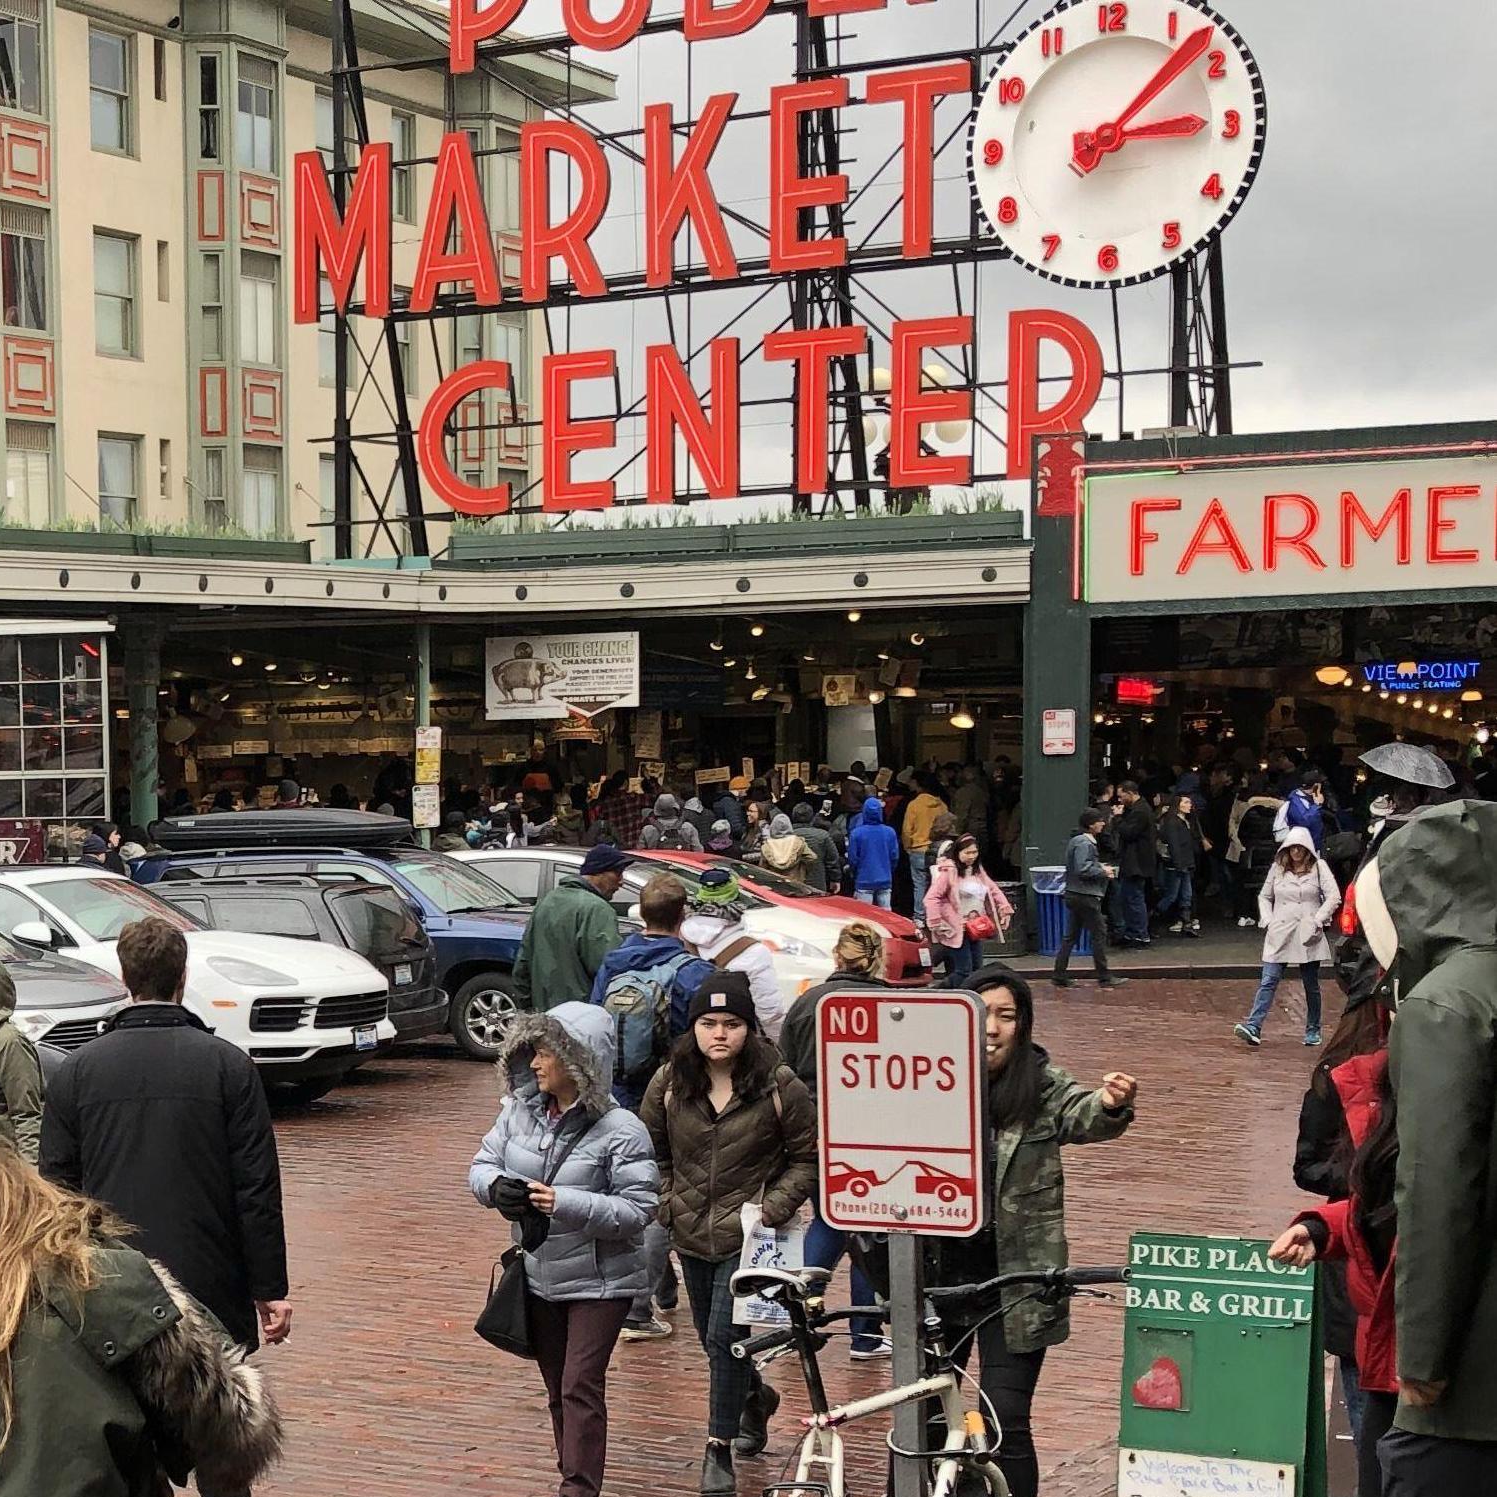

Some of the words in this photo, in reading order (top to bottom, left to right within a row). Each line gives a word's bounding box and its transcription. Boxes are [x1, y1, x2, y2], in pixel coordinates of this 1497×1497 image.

[1098, 3, 1128, 32] 12
[1168, 11, 1177, 39] 1
[1042, 27, 1063, 57] 11
[1208, 51, 1226, 78] 2
[999, 77, 1025, 105] 10
[1222, 110, 1240, 138] 3
[983, 139, 1003, 166] 9
[295, 61, 974, 325] MARKET
[1200, 173, 1224, 200] 4
[998, 196, 1018, 224] 8
[1042, 235, 1061, 261] 7
[1161, 223, 1181, 248] 5
[1097, 245, 1119, 272] 6
[418, 309, 1104, 516] CENTER
[1129, 484, 1497, 576] FARME
[547, 641, 580, 658] YOUR
[582, 640, 635, 657] CHANGE
[1389, 682, 1420, 690] PUBLIC
[1422, 680, 1462, 689] SEATING
[829, 1006, 869, 1036] NO
[840, 1053, 956, 1092] STOPS
[1131, 1243, 1201, 1268] PIKE
[1125, 1286, 1185, 1312] BAR
[1188, 1291, 1211, 1314] &
[1218, 1293, 1312, 1322] GRILL
